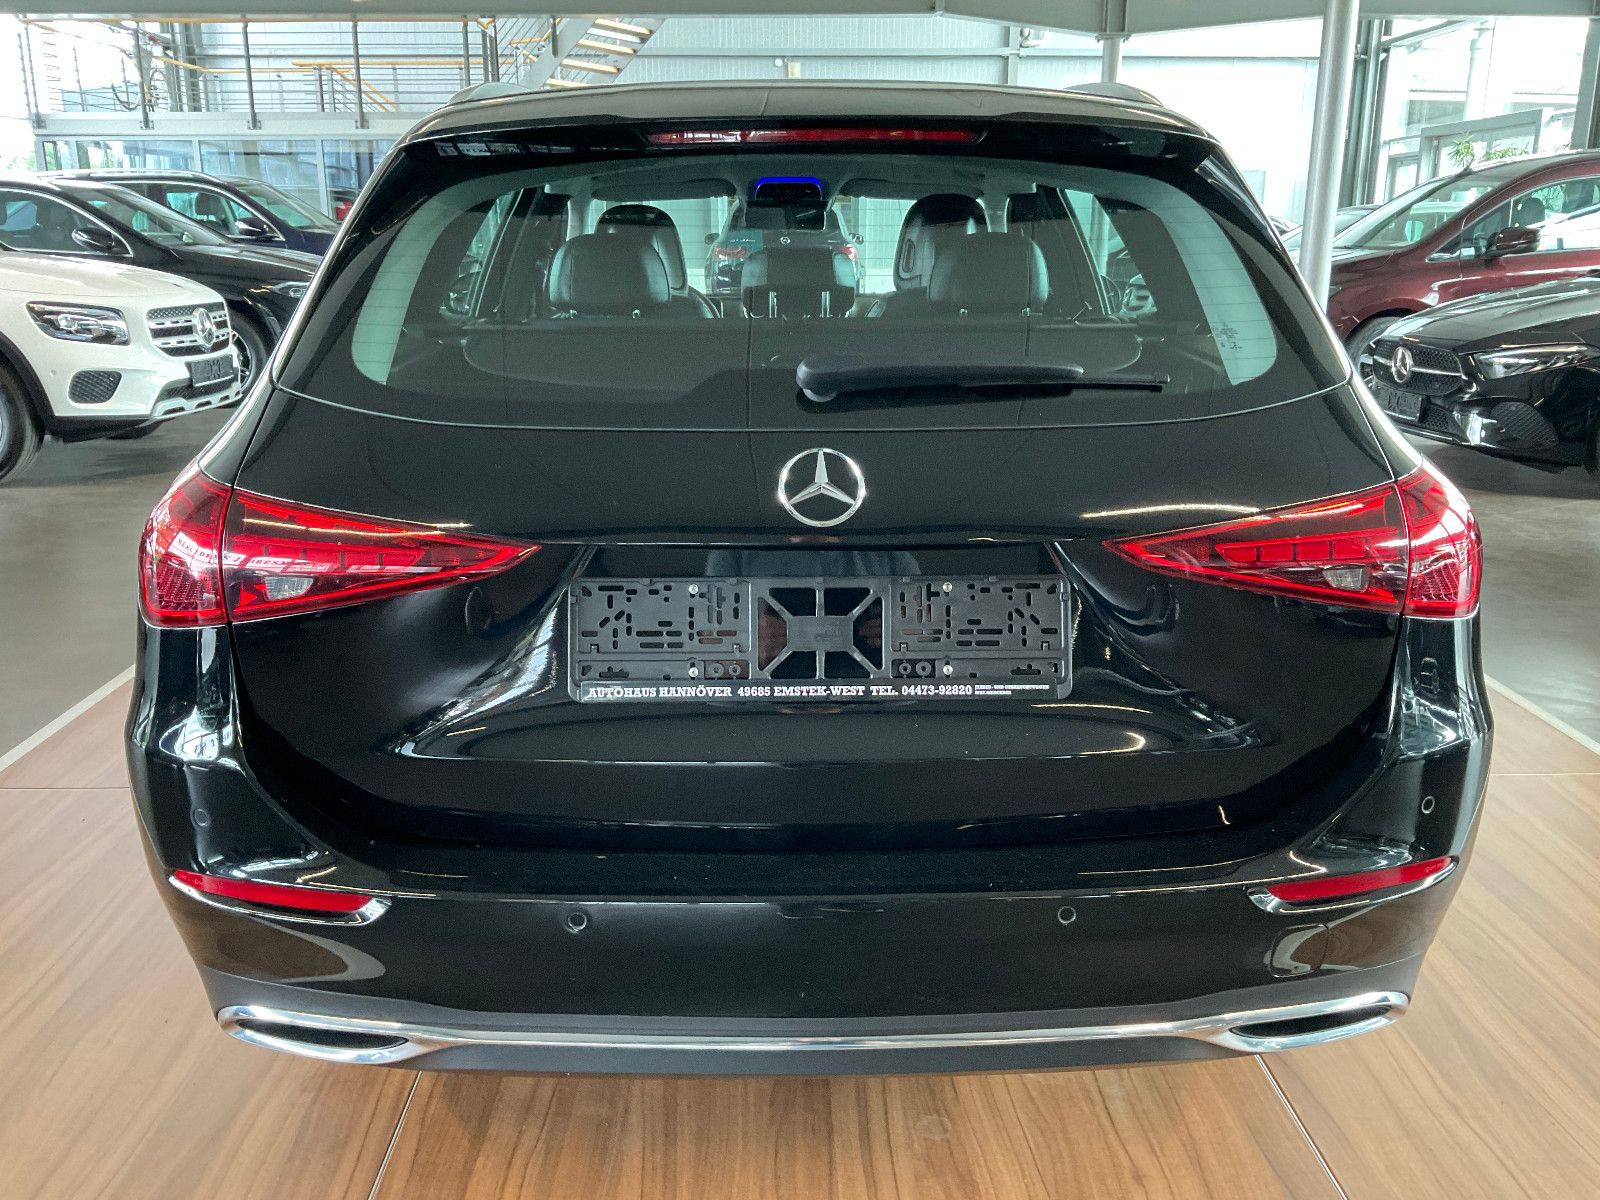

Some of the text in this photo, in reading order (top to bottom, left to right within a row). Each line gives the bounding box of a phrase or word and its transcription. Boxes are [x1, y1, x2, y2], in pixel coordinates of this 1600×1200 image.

[588, 686, 657, 698] AUTOHAUS
[658, 684, 733, 697] HANNÖVER
[737, 686, 771, 697] 49685
[773, 685, 866, 697] EMSTEK-WEST
[870, 685, 899, 696] TEL.
[901, 684, 973, 695] 04473-92820
